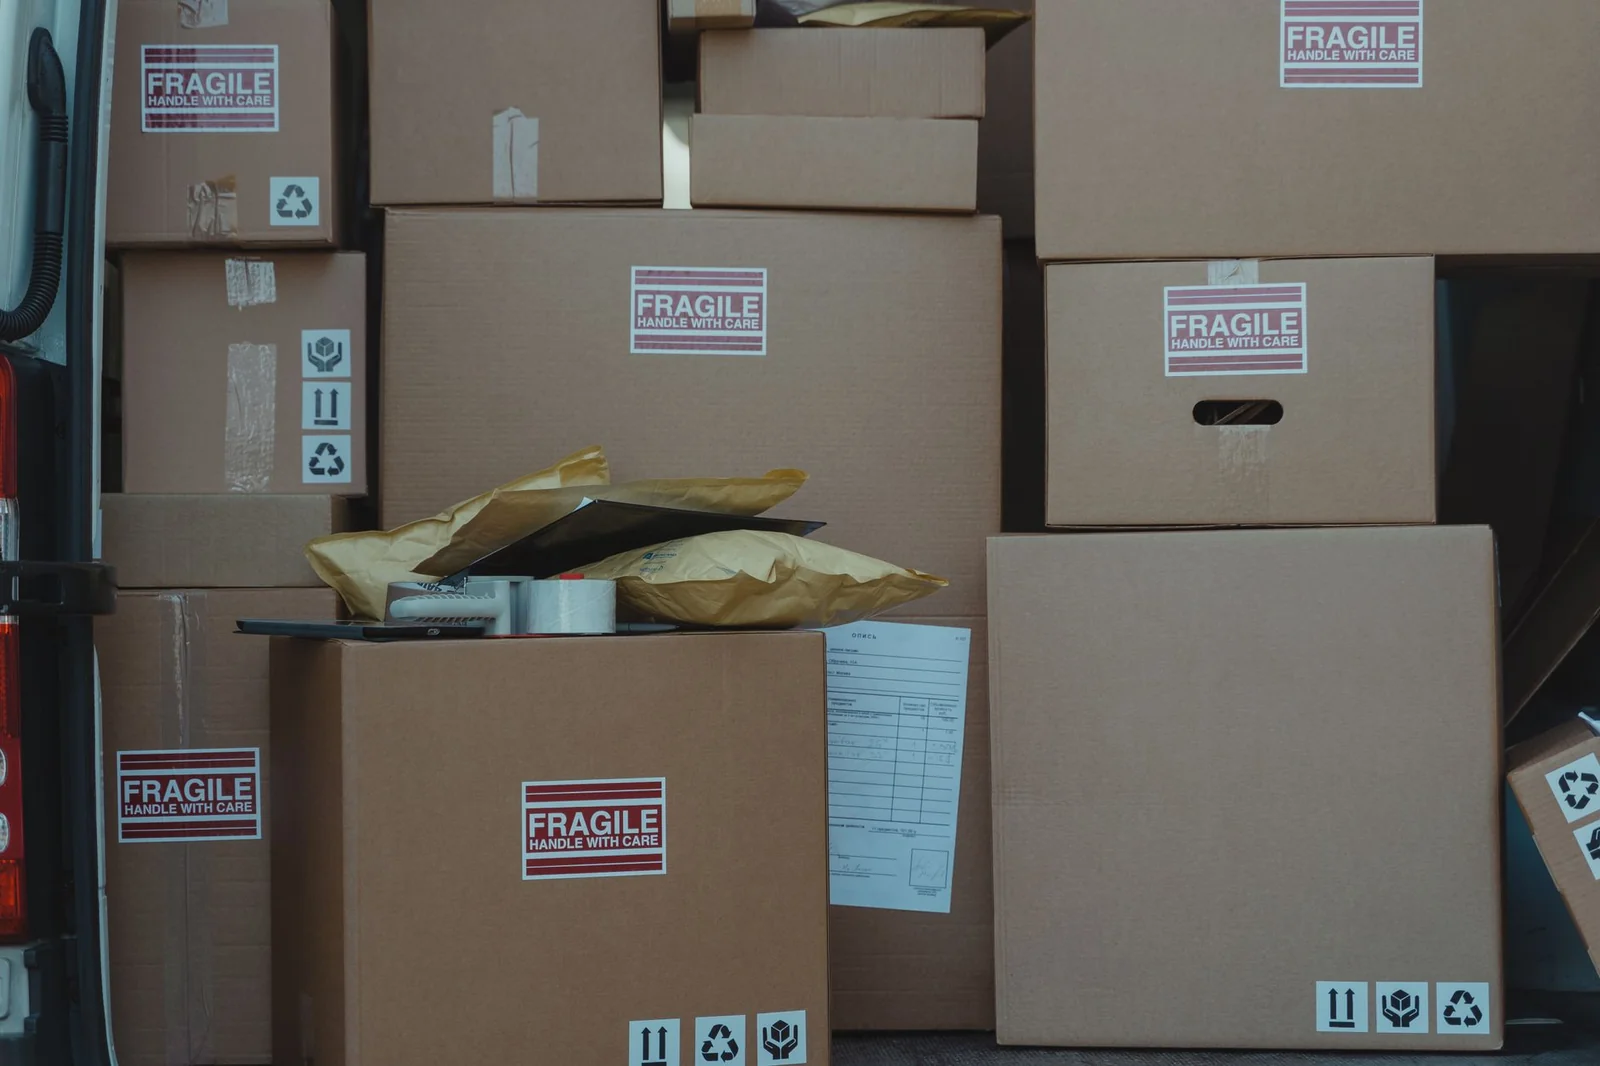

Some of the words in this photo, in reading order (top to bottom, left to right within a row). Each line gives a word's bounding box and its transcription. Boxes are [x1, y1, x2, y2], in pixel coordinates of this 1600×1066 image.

[1288, 26, 1415, 49] FRAGILE
[1288, 50, 1340, 60] HANDLE
[1343, 50, 1376, 60] WITH
[1379, 50, 1415, 60] CARE
[149, 72, 271, 95] FRAGILE
[149, 96, 199, 106] HANDLE
[202, 95, 233, 106] WITH
[236, 95, 271, 106] CARE
[638, 295, 759, 318] FRAGILE
[638, 317, 688, 328] HANDLE
[691, 318, 722, 328] WITH
[725, 318, 759, 329] CARE
[1172, 312, 1298, 337] FRAGILE
[1171, 338, 1224, 349] HANDLE
[1227, 337, 1259, 348] WITH
[1262, 336, 1299, 347] CARE
[851, 632, 877, 640] ОПИСЬ
[124, 778, 252, 802] FRAGILE
[125, 803, 177, 815] HANDLE
[180, 802, 213, 814] WITH
[216, 801, 252, 813] CARE
[530, 809, 658, 837] FRAGILE
[530, 837, 583, 850] HANDLE
[586, 836, 619, 848] WITH
[622, 834, 658, 847] CARE
